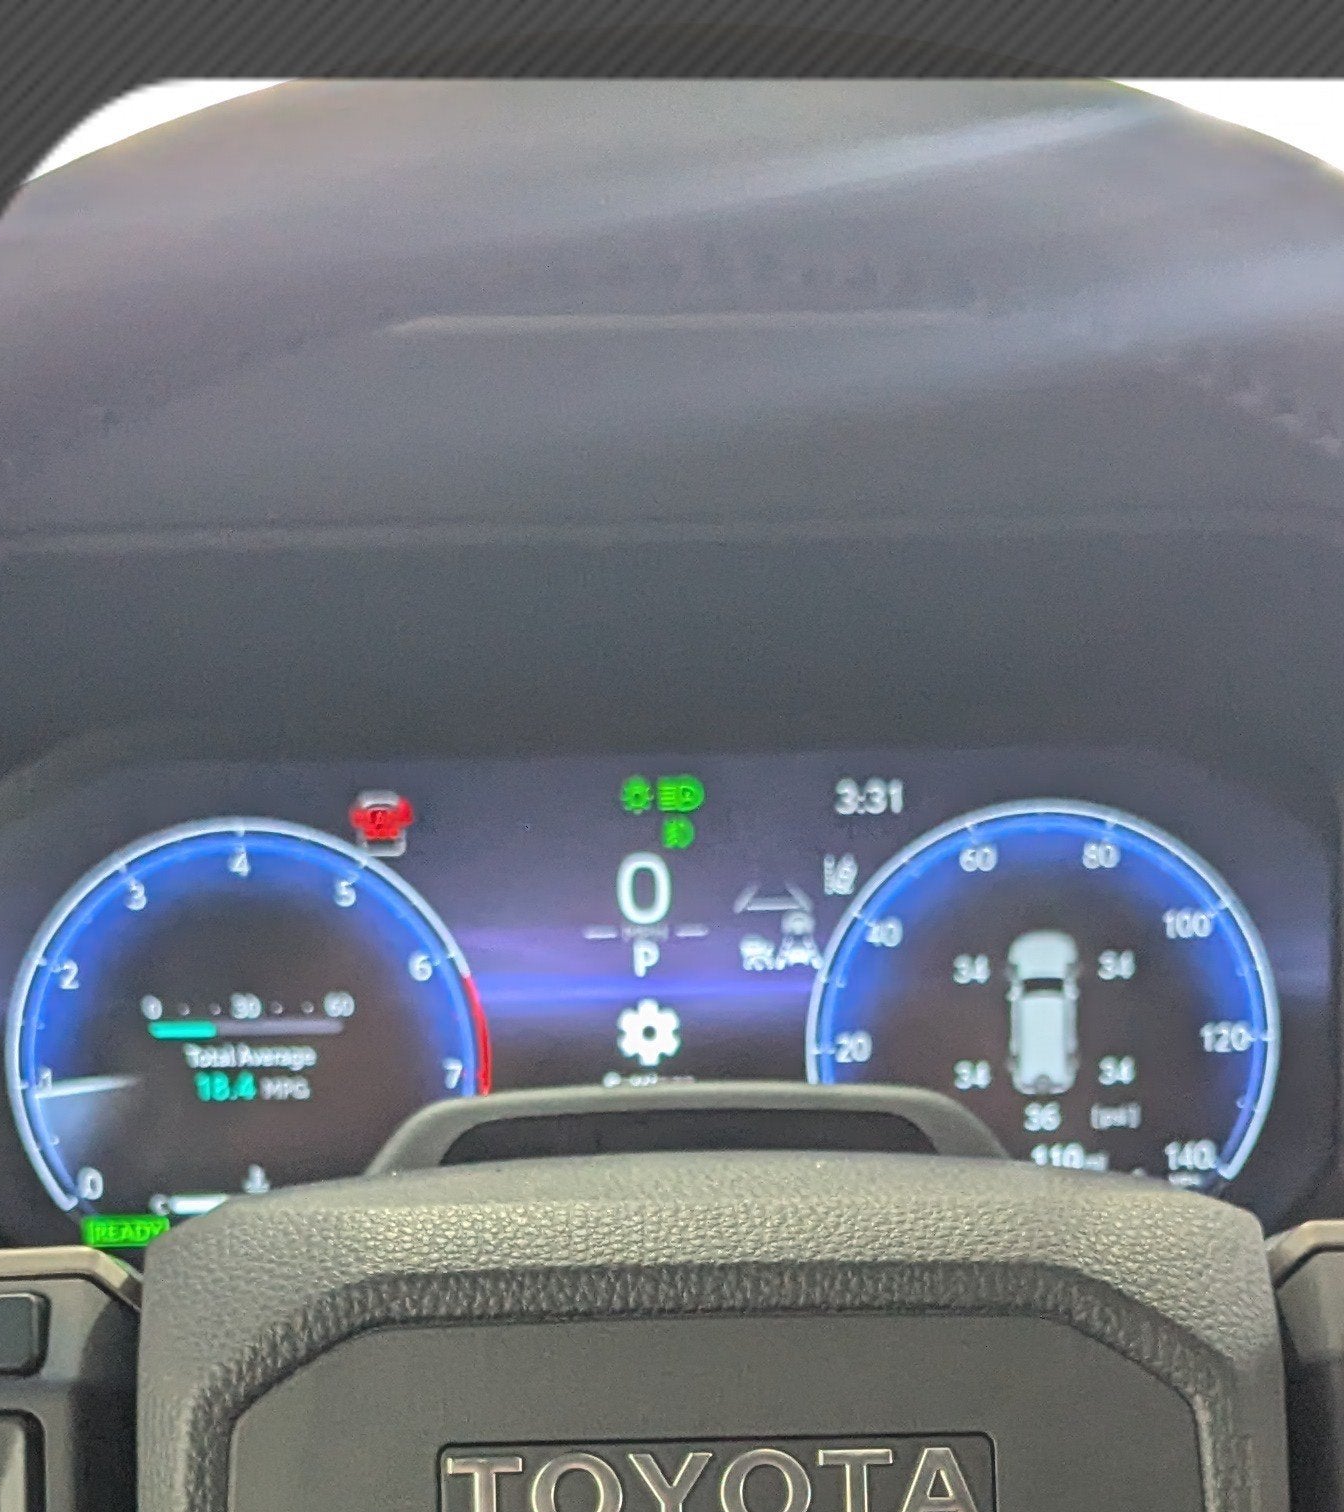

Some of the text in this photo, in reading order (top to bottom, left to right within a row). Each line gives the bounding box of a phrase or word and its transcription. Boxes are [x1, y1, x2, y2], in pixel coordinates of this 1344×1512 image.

[834, 779, 904, 816] 3:31
[227, 846, 250, 878] 4
[959, 843, 998, 872] 60
[124, 878, 147, 911] 3
[332, 876, 356, 908] 5
[616, 851, 672, 925] 0
[1162, 908, 1213, 939] 100
[408, 950, 434, 982] 6
[632, 938, 661, 977] P
[59, 958, 80, 990] 2
[836, 1030, 873, 1064] 20
[1199, 1020, 1250, 1053] 120
[184, 1042, 318, 1071] Total Average
[443, 1058, 462, 1090] 7
[1164, 1140, 1217, 1171] 140
[76, 1166, 104, 1200] 0
[92, 1217, 170, 1245] READY
